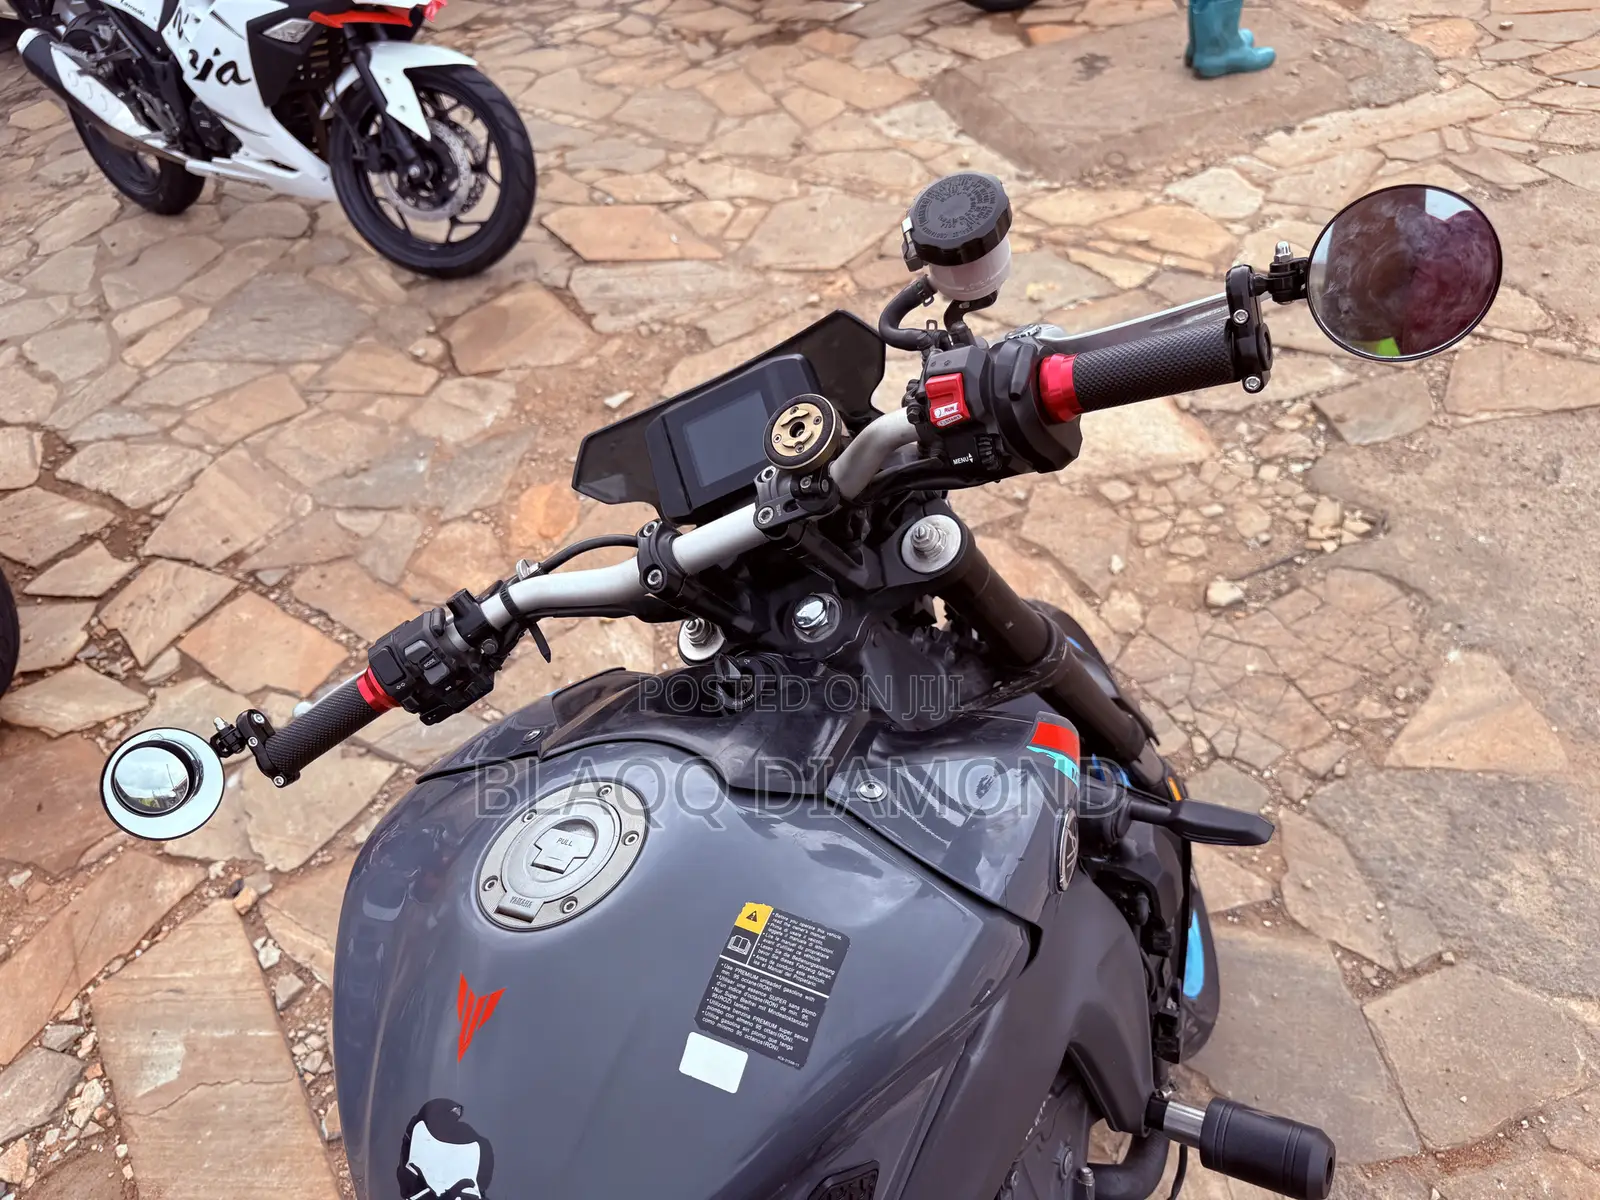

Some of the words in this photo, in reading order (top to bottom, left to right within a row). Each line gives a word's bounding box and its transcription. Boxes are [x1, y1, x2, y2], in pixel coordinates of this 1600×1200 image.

[952, 456, 969, 465] MENU
[423, 658, 436, 668] MODE
[556, 838, 573, 847] PULL
[510, 896, 533, 909] YAMAHA
[734, 968, 759, 980] PREMIUM
[752, 1016, 778, 1030] PREMIUM
